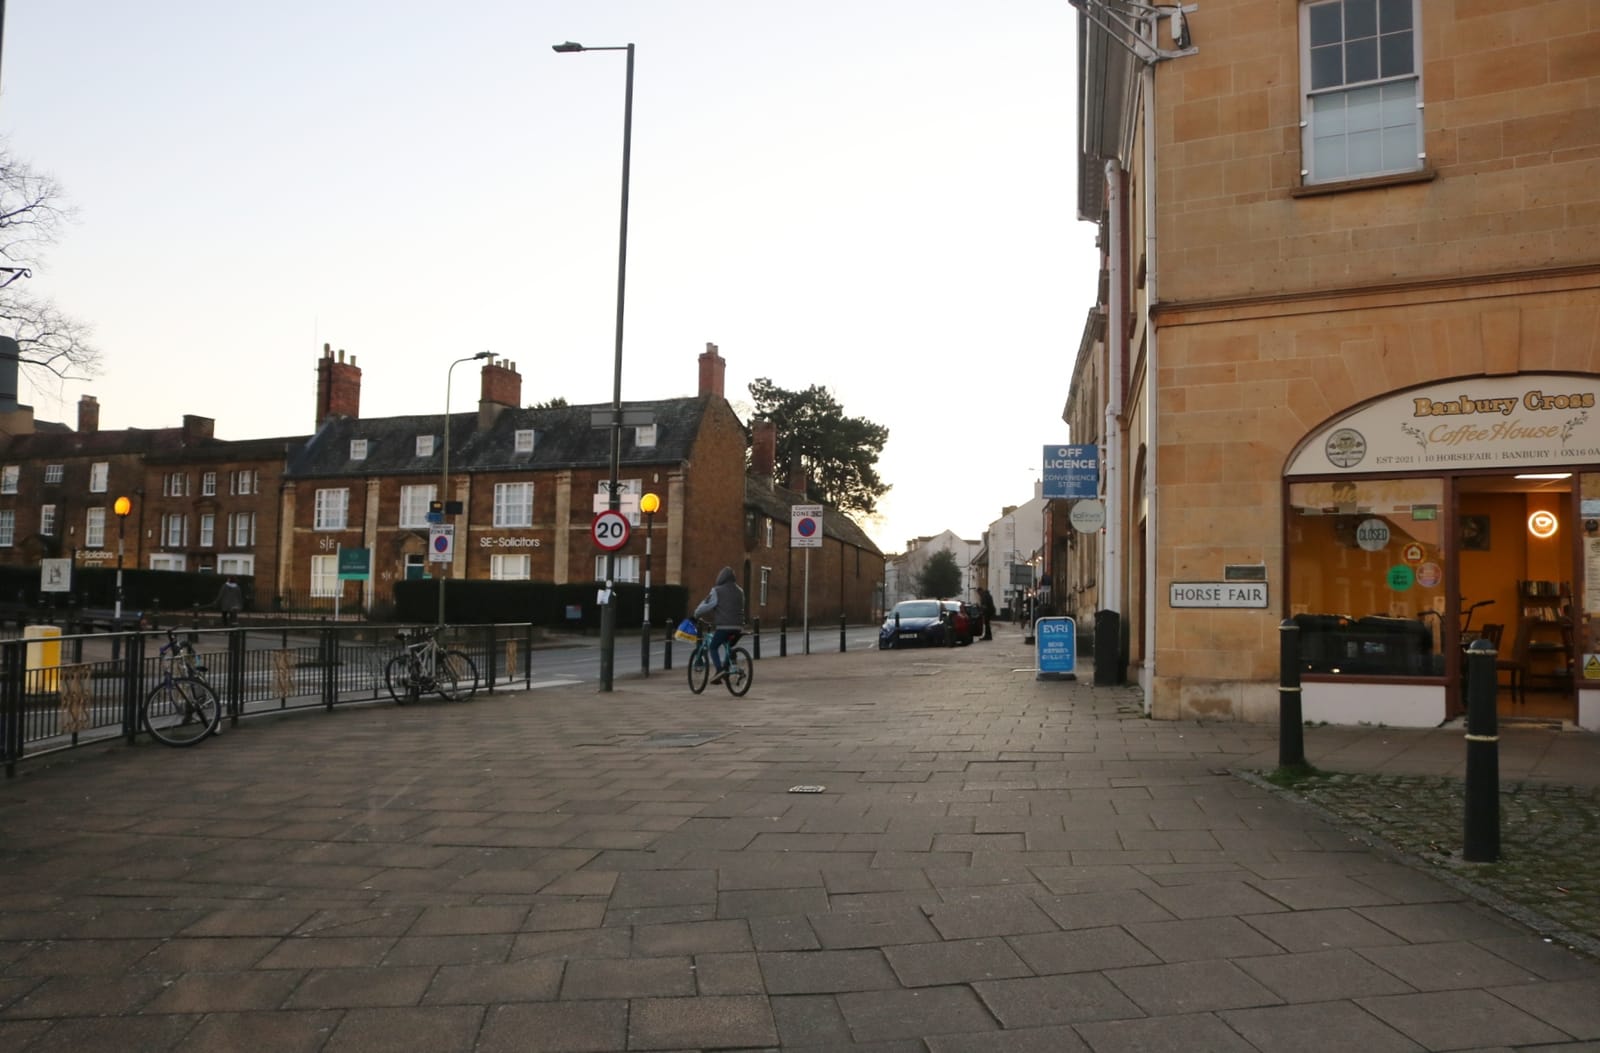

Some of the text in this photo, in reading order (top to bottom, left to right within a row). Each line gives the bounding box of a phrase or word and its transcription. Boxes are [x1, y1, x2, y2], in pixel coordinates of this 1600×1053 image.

[1413, 390, 1595, 417] Banbury Cross
[1428, 419, 1562, 448] Coffee House
[1058, 448, 1083, 457] OFF
[1376, 456, 1394, 465] EST
[1395, 455, 1415, 464] 2021
[1424, 454, 1435, 463] 10
[1436, 451, 1492, 462] HORSEFAIR
[1501, 449, 1551, 460] BANBURY
[1560, 448, 1587, 458] OX16
[1045, 459, 1096, 469] LICENCE
[596, 522, 623, 539] 20
[1359, 527, 1388, 542] CLOSED
[1174, 588, 1263, 601] HORSE FAIR
